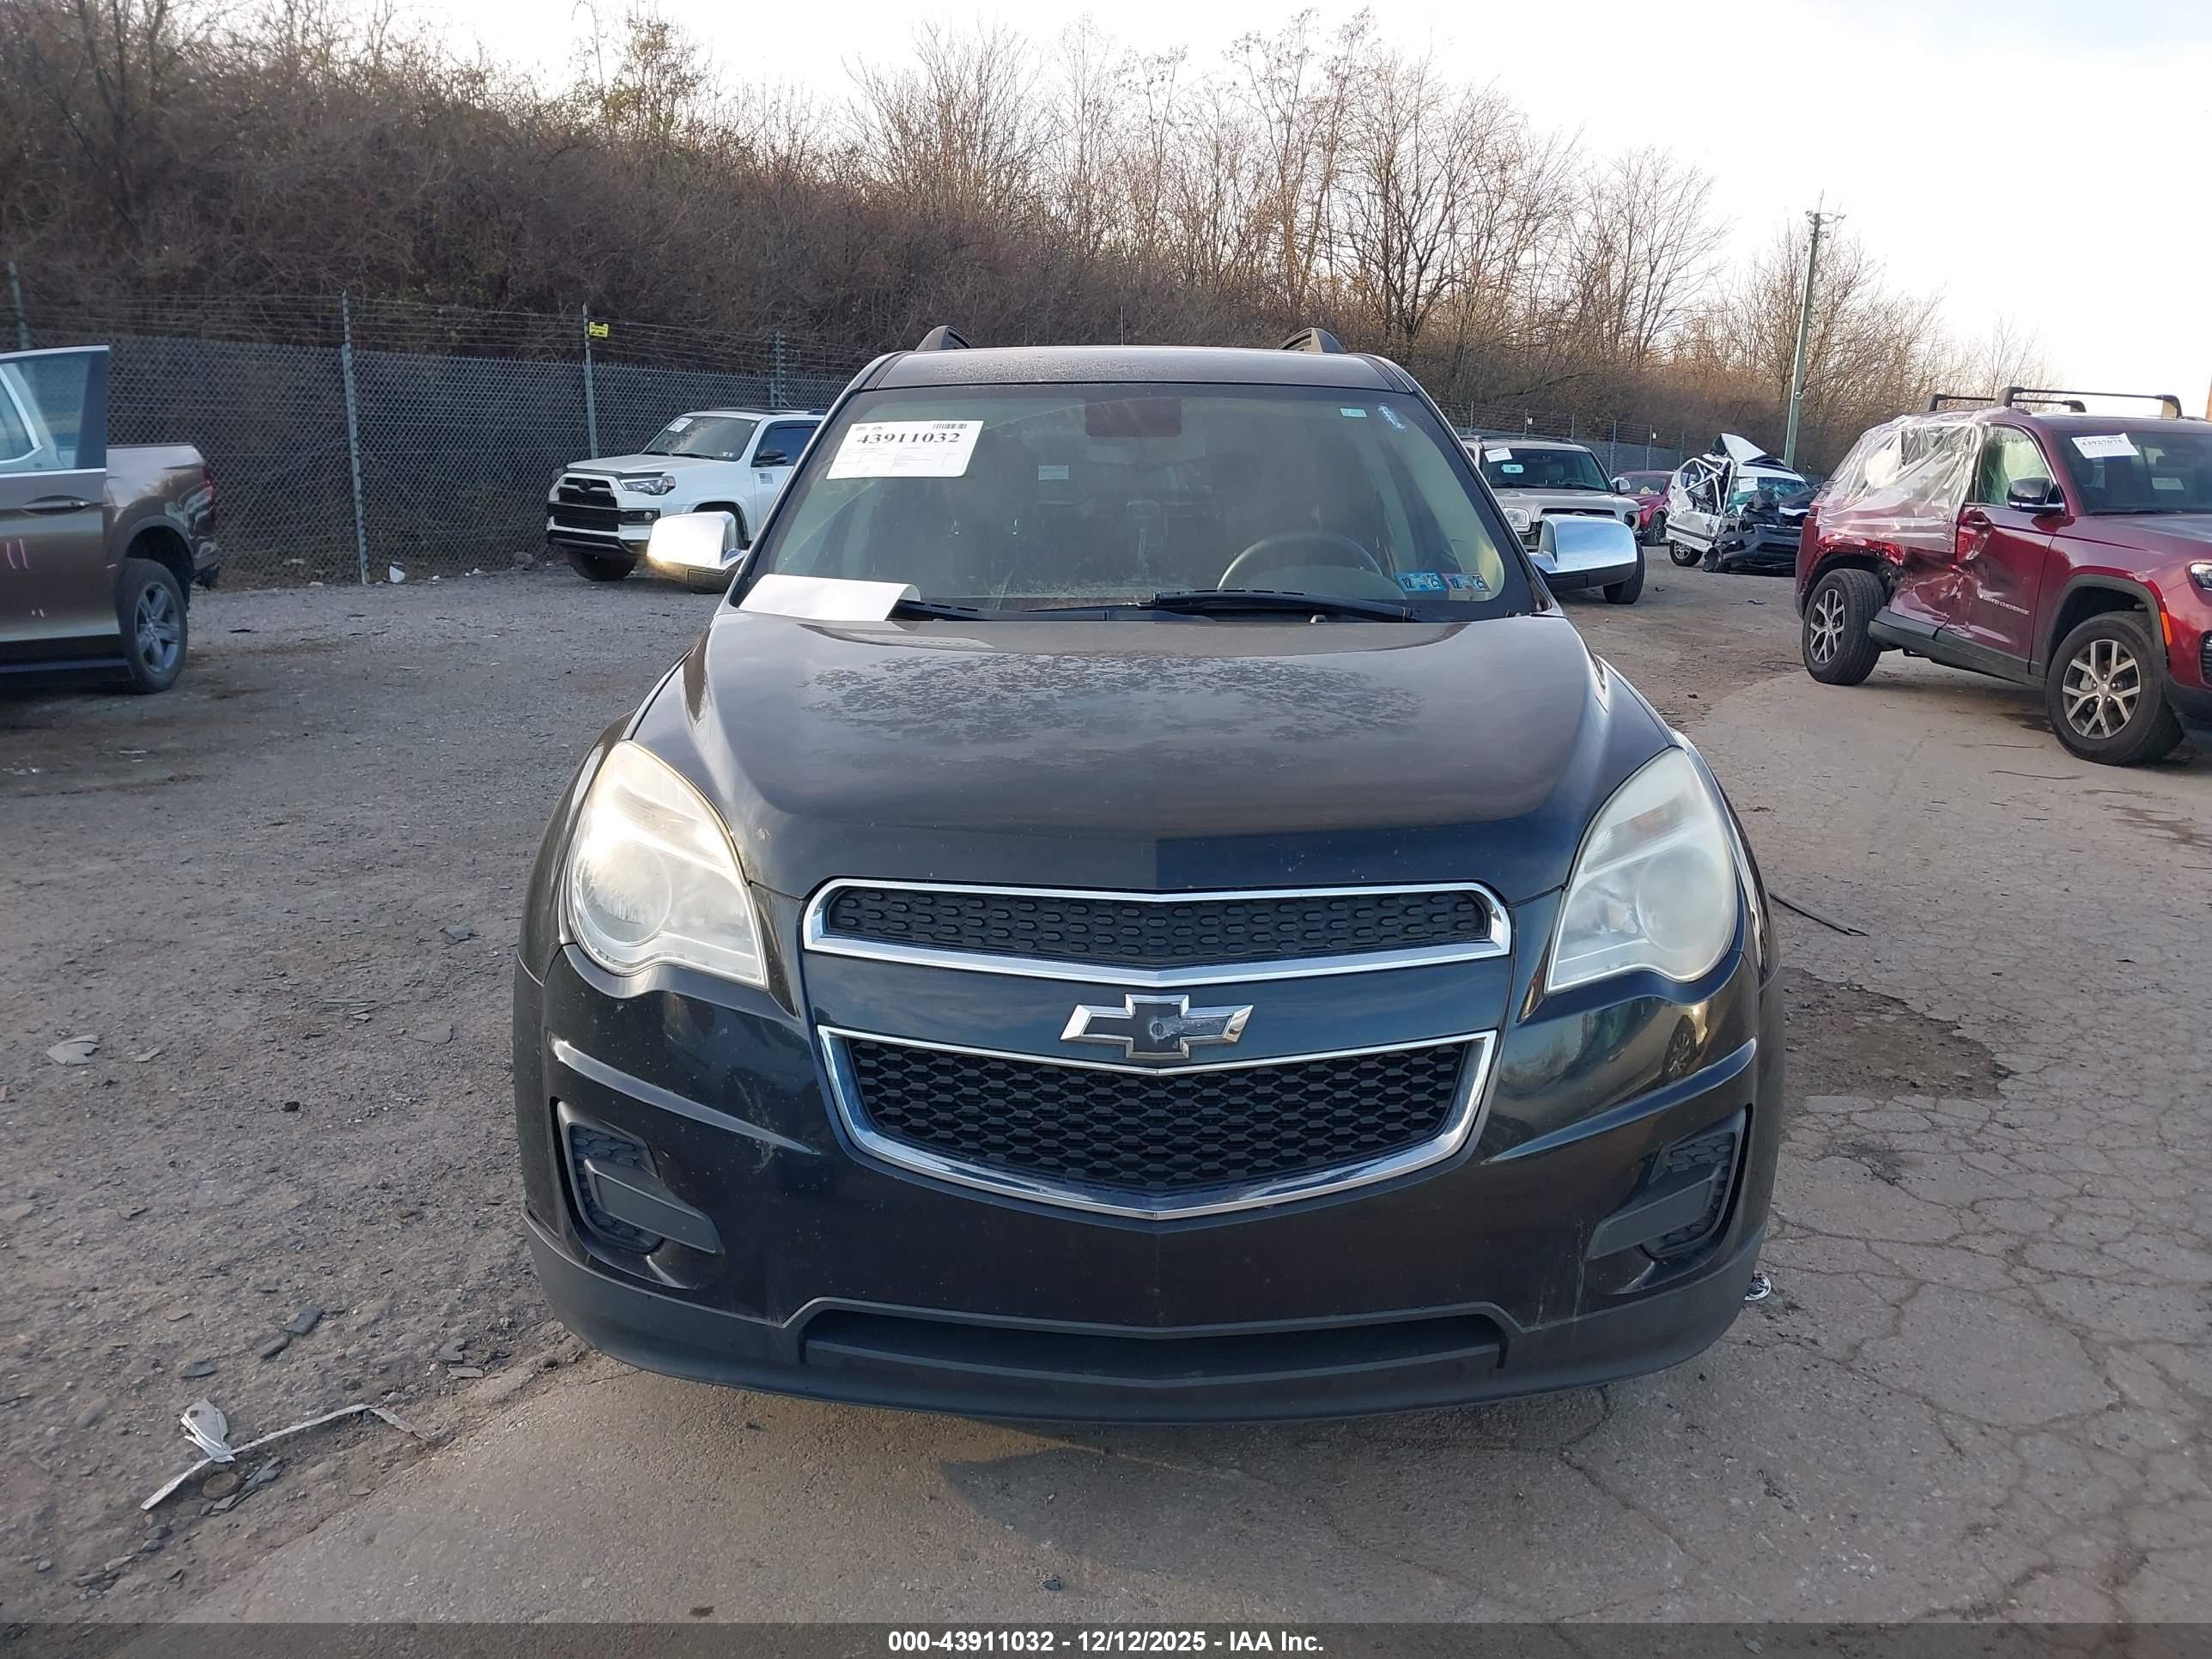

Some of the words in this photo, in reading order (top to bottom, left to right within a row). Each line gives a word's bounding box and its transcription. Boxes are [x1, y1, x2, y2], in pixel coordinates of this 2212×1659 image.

[857, 432, 961, 444] 43911032
[1401, 577, 1415, 589] 12
[1426, 574, 1442, 588] 25
[1449, 577, 1462, 590] 12
[1472, 575, 1487, 589] 25
